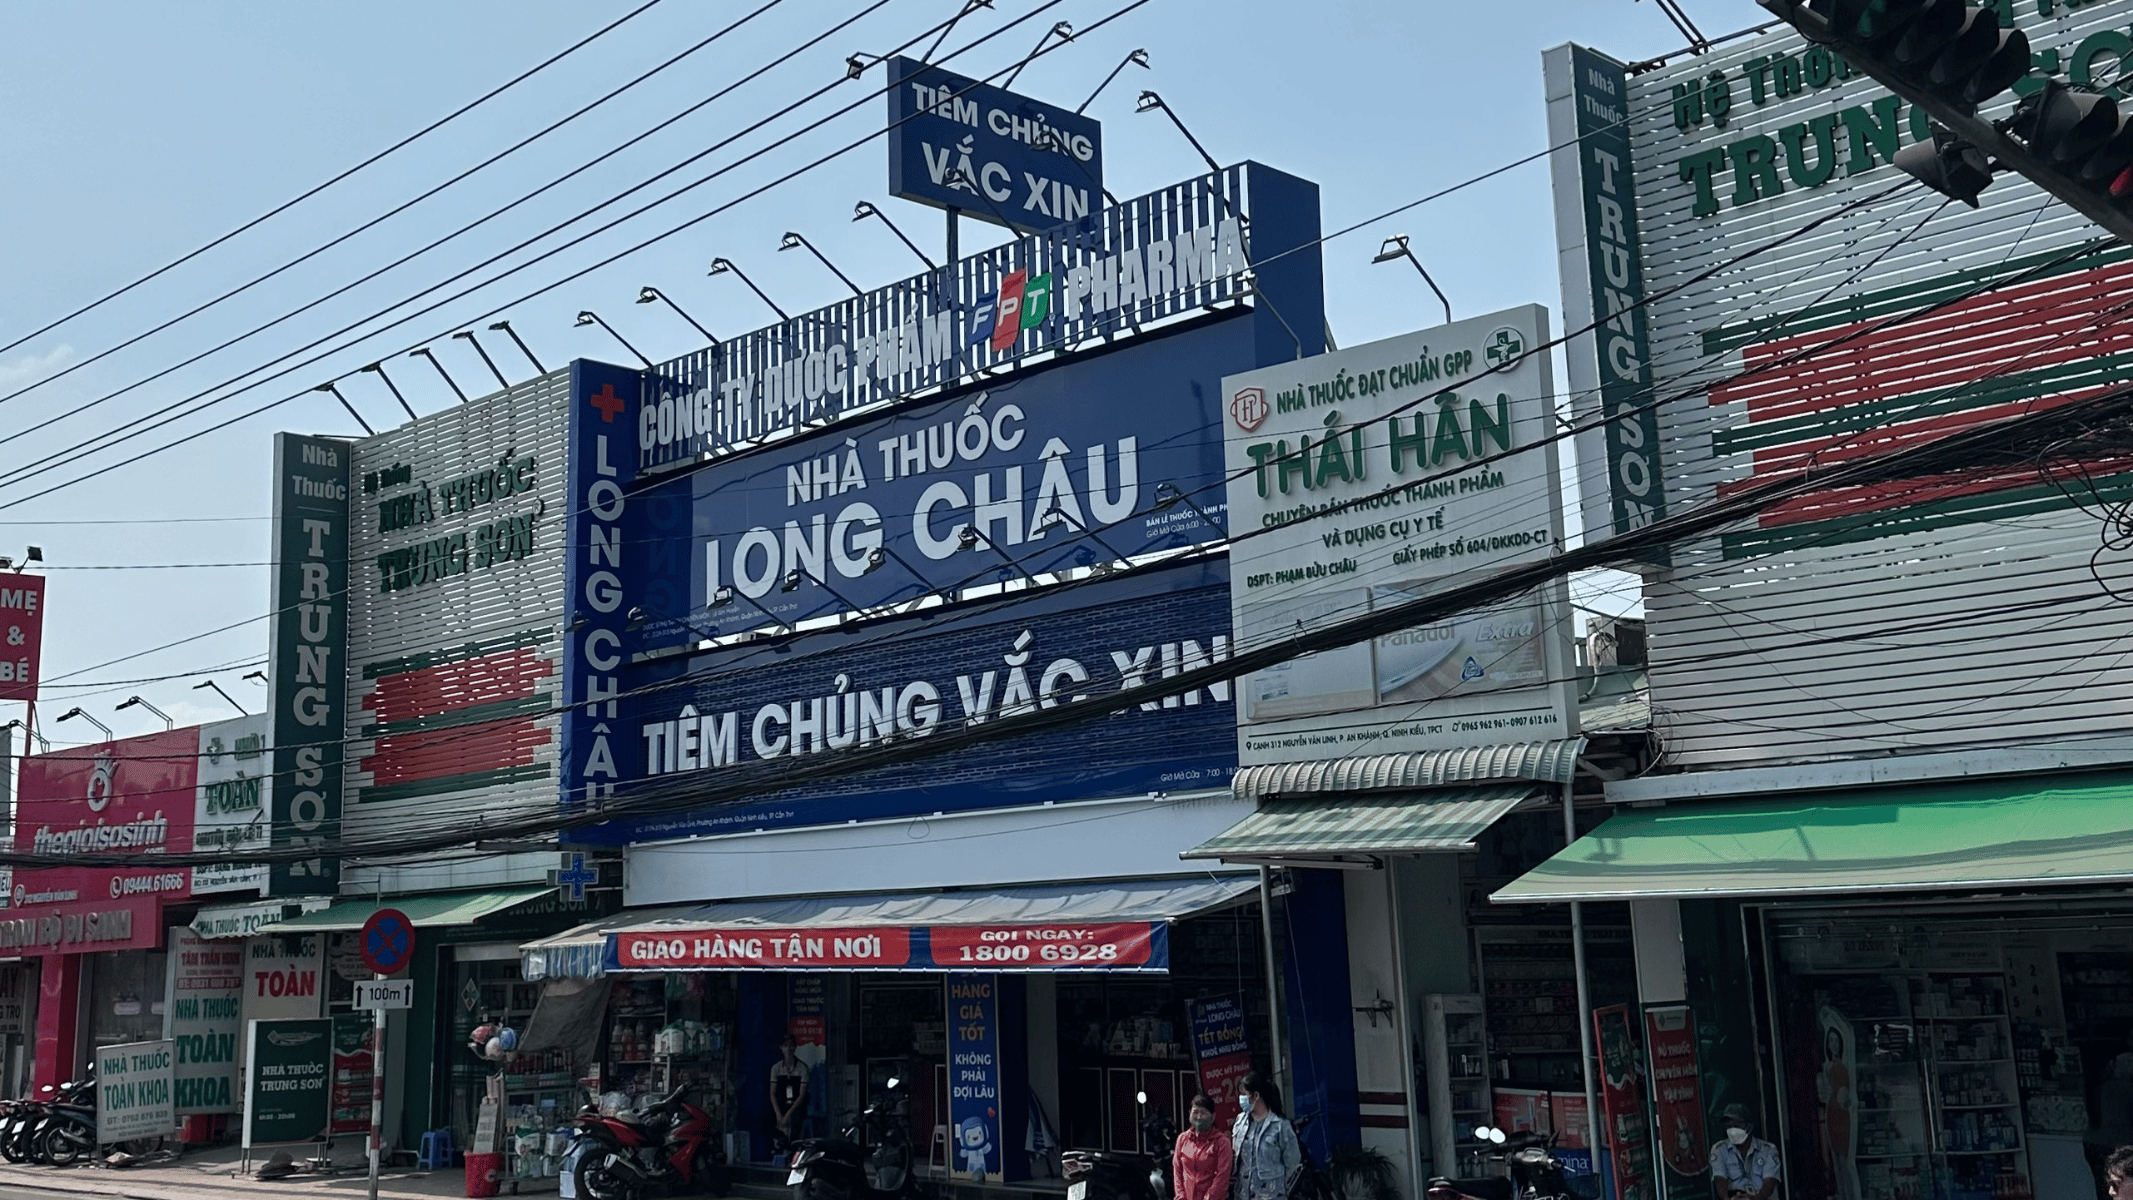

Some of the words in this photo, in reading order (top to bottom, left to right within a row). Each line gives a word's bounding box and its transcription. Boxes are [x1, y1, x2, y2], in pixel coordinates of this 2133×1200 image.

[1588, 66, 1615, 95] Nhà
[911, 81, 979, 128] TIÊM
[987, 108, 1094, 162] CHỦNG
[1583, 92, 1624, 128] Thuốc
[921, 134, 1012, 202] VẮC
[1022, 171, 1089, 221] XIN
[1593, 146, 1642, 384] TRUNG
[639, 388, 713, 450] CÔNG
[721, 373, 756, 428] TY
[764, 344, 847, 414] DƯỢC
[857, 304, 952, 386] PHẨM
[1068, 216, 1246, 322] PHARMA
[1276, 384, 1307, 414] NHÀ
[1308, 368, 1356, 406] THUỐC
[1358, 375, 1386, 399] ĐẠT
[1390, 345, 1441, 390] CHUẨN
[1443, 349, 1473, 378] GPP
[302, 443, 338, 468] Nhà
[787, 438, 868, 507] NHÀ
[879, 391, 1027, 478] THUỐC
[1246, 409, 1366, 499] THÁI
[1389, 391, 1513, 475] HÂN
[292, 475, 346, 501] Thuốc
[438, 446, 536, 517] THUỐC
[1458, 463, 1505, 494] PHẨM
[585, 435, 626, 614] LONG
[706, 502, 885, 609] LONG
[912, 436, 1140, 560] CHÂU
[1169, 508, 1193, 521] THUỐC
[1322, 527, 1342, 548] VÀ
[1344, 524, 1387, 547] DỤNG
[1389, 519, 1409, 540] CỤ
[1413, 518, 1423, 533] Y
[1426, 506, 1445, 532] TẾ
[377, 533, 468, 594] TRUNG
[1392, 544, 1417, 566] GIẤY
[1420, 542, 1447, 562] PHÉP
[1449, 535, 1465, 556] SỐ
[1247, 573, 1275, 589] DSPT:
[1275, 568, 1305, 584] PHẠM
[1328, 558, 1358, 575] CHÂU
[6, 626, 26, 646] &
[294, 519, 332, 727] TRUNG
[1475, 621, 1535, 643] Extra
[0, 656, 30, 682] BÉ
[642, 704, 739, 775] TIÊM
[751, 673, 943, 760] CHỦNG
[956, 628, 1090, 727] VẮC
[1110, 634, 1234, 714] XIN
[1271, 739, 1282, 749] 312
[1282, 734, 1308, 748] NGUYỄN
[1308, 736, 1321, 746] VĂN
[1346, 732, 1356, 742] AN
[1391, 728, 1408, 737] NINH
[1427, 725, 1443, 735] TPCT
[1461, 722, 1478, 732] 0965
[1480, 720, 1493, 730] 962
[1529, 715, 1543, 726] 612
[1544, 714, 1558, 724] 616
[204, 770, 263, 816] TOÀN
[252, 940, 275, 959] NHÀ
[632, 937, 687, 960] GIAO
[693, 933, 763, 960] HÀNG
[769, 932, 825, 962] TẬN
[833, 934, 882, 960] NƠI
[980, 929, 1018, 942] GỌI
[1026, 929, 1095, 942] NGAY:
[959, 944, 1030, 962] 1800
[1039, 943, 1118, 962] 6928
[255, 963, 317, 998] TOÀN
[369, 987, 400, 1001] 100m
[951, 980, 991, 999] HÀNG
[175, 994, 199, 1020] NHÀ
[202, 991, 240, 1020] THUỐC
[959, 1000, 985, 1020] GIÁ
[176, 1028, 236, 1064] TOÀN
[958, 1020, 986, 1042] TỐT
[104, 1052, 128, 1076] NHÀ
[131, 1046, 170, 1072] THUỐC
[262, 1063, 286, 1077] NHÀ
[954, 1051, 992, 1066] KHÔNG
[960, 1065, 987, 1082] PHẢI
[104, 1077, 135, 1112] TOÀN
[138, 1078, 169, 1107] KHOA
[173, 1077, 232, 1108] KHOA
[260, 1078, 299, 1093] TRUNG
[952, 1083, 973, 1101] ĐỢI
[974, 1083, 995, 1099] LÂU
